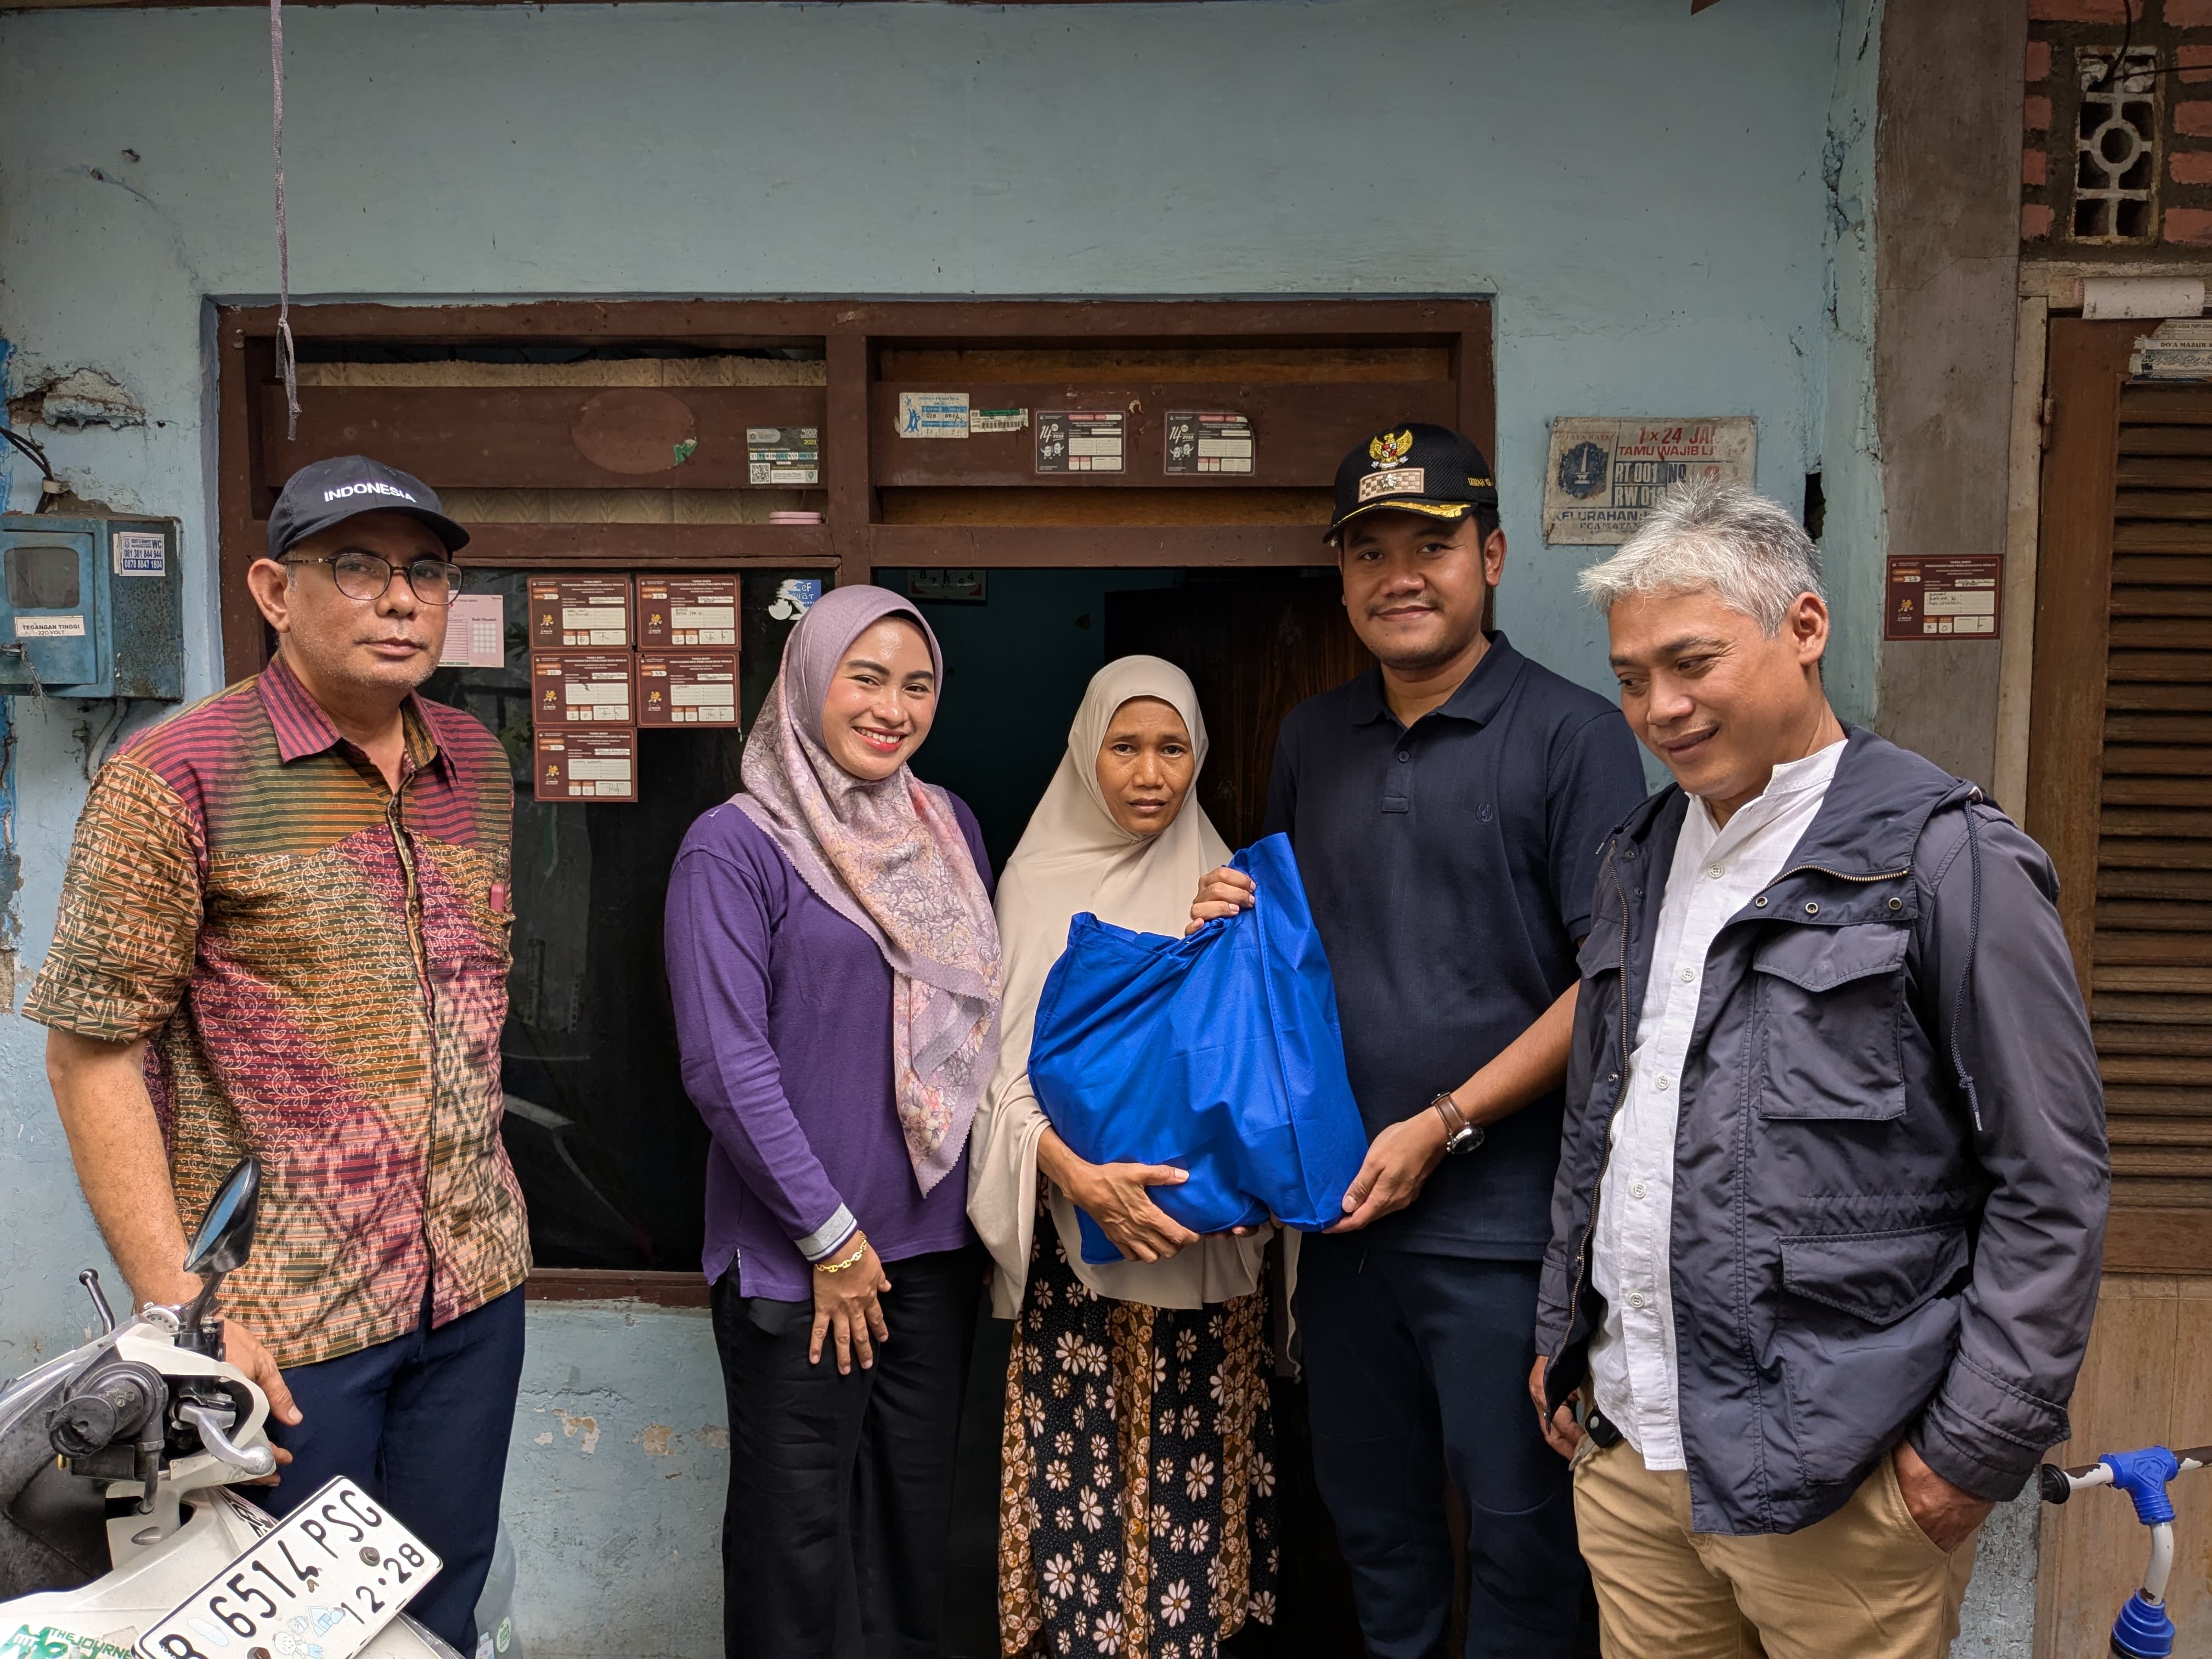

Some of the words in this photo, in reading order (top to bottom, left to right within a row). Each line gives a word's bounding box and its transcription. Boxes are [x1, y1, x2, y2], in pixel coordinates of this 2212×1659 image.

[1639, 427, 1646, 444] 1
[1661, 427, 1683, 444] 24
[1618, 446, 1655, 456] TAMU
[1657, 446, 1699, 456] WAJIB
[1616, 463, 1632, 483] RT
[1634, 463, 1658, 483] 001
[324, 483, 417, 503] INDONESIA
[1615, 487, 1638, 506] RW
[152, 540, 162, 549] WC
[124, 549, 133, 557] 081
[144, 550, 153, 558] 844
[125, 560, 137, 568] 0878
[138, 560, 150, 568] 8847
[151, 560, 162, 569] 1804
[920, 570, 927, 579] 8
[944, 576, 950, 585] 6
[967, 572, 974, 581] 4
[159, 1634, 208, 1659] B
[209, 1540, 319, 1638] 6514
[300, 1489, 382, 1559] PSG
[500, 1624, 509, 1638] BPA
[50, 1628, 75, 1641] THE
[71, 1636, 132, 1659] JOURNE
[500, 1632, 509, 1645] FREE
